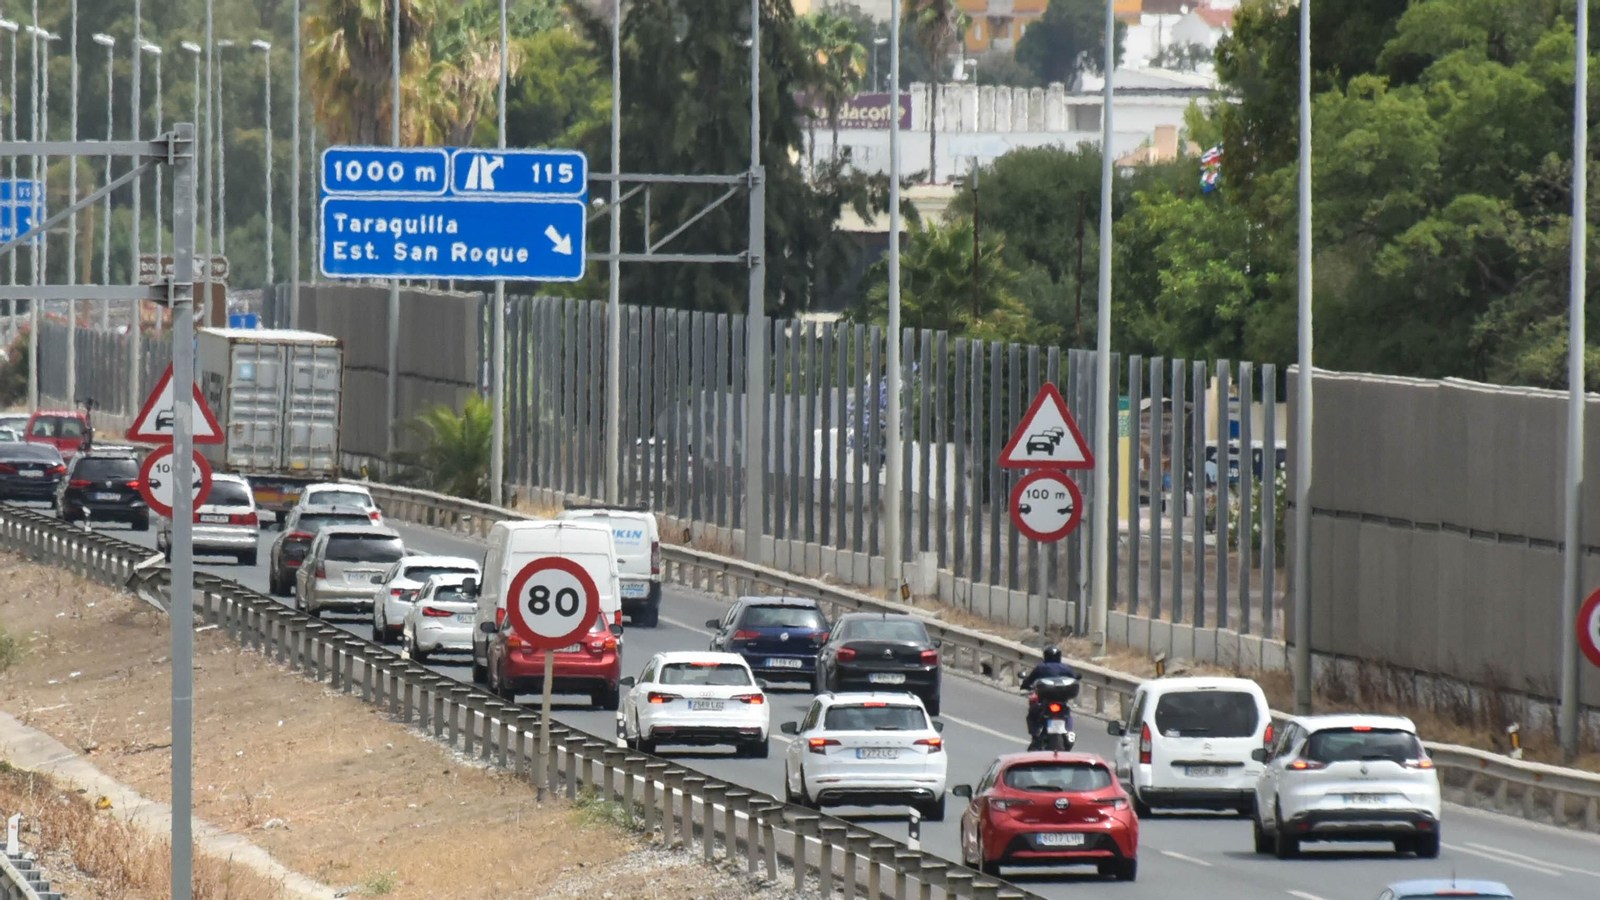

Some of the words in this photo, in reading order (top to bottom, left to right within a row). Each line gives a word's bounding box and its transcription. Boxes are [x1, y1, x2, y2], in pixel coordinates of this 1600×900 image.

[334, 160, 404, 183] 1000
[414, 165, 437, 183] m
[531, 162, 574, 183] 115
[333, 212, 459, 239] Taraguilla
[333, 241, 380, 260] Est.
[393, 242, 439, 262] San
[451, 242, 529, 267] Roque
[156, 463, 174, 473] 10
[1026, 489, 1050, 500] 100
[1055, 491, 1066, 500] m
[527, 585, 580, 617] 80
